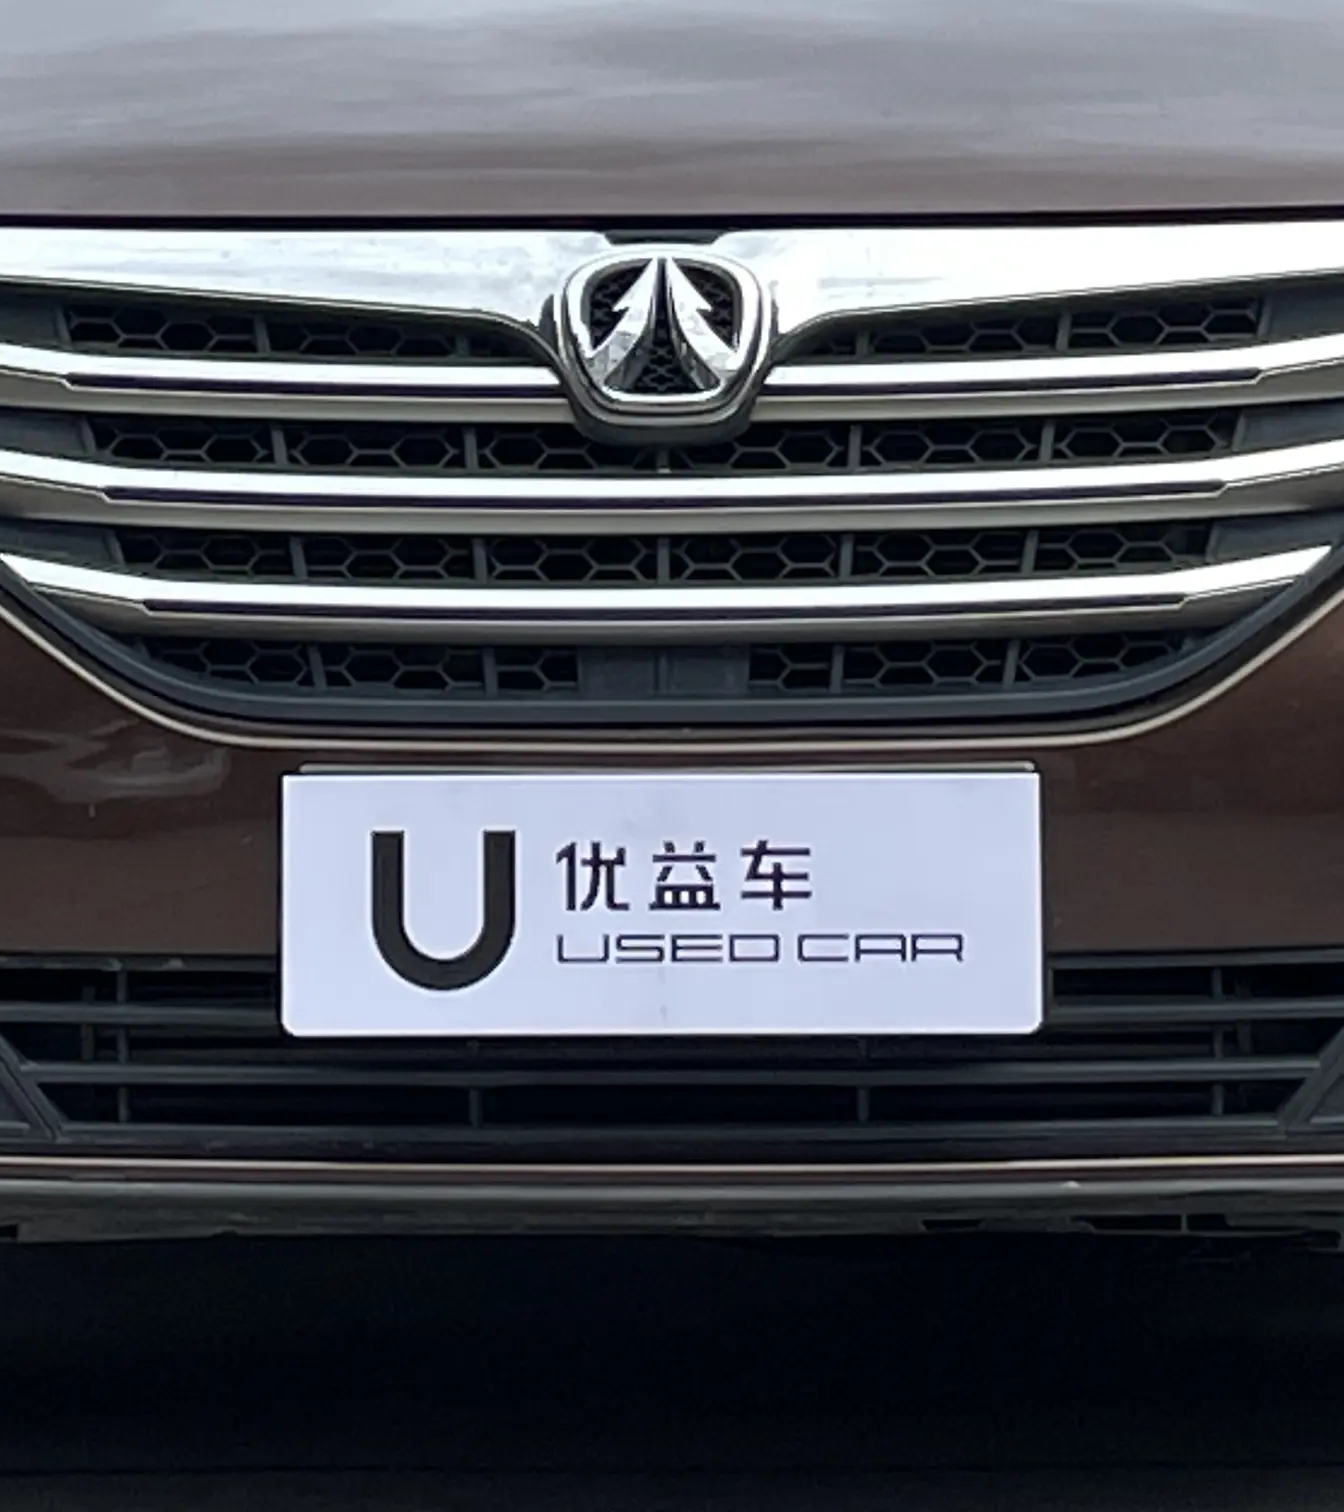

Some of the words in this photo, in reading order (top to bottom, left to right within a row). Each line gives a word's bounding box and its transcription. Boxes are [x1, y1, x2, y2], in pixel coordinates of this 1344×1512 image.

[371, 829, 516, 992] U
[556, 839, 813, 912] 优益车
[557, 934, 780, 963] USED
[797, 933, 964, 963] CAR
